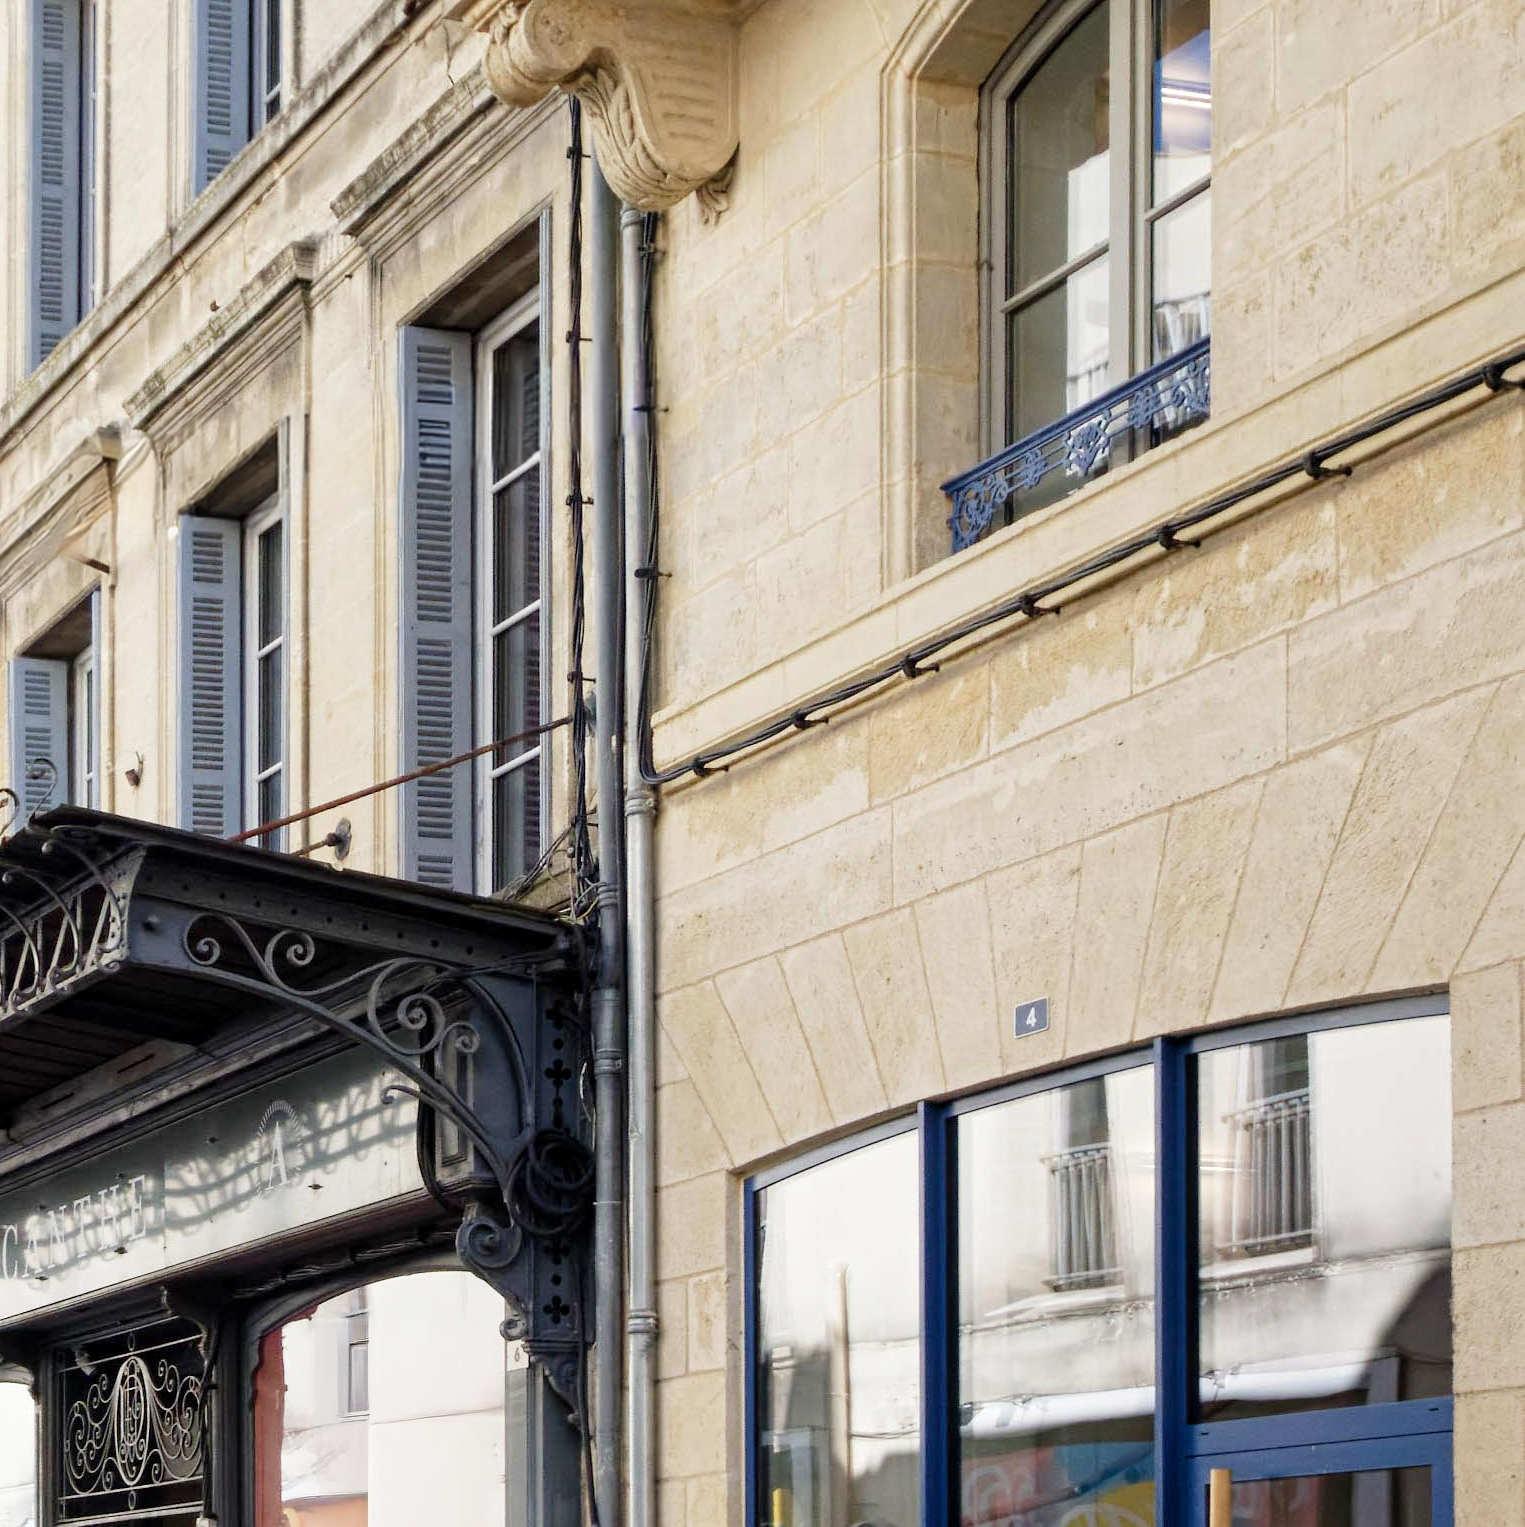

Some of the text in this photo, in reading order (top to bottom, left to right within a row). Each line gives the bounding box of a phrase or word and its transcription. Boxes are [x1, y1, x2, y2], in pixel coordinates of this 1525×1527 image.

[1026, 1006, 1037, 1028] 4
[268, 1120, 290, 1192] A
[514, 1346, 521, 1362] 6
